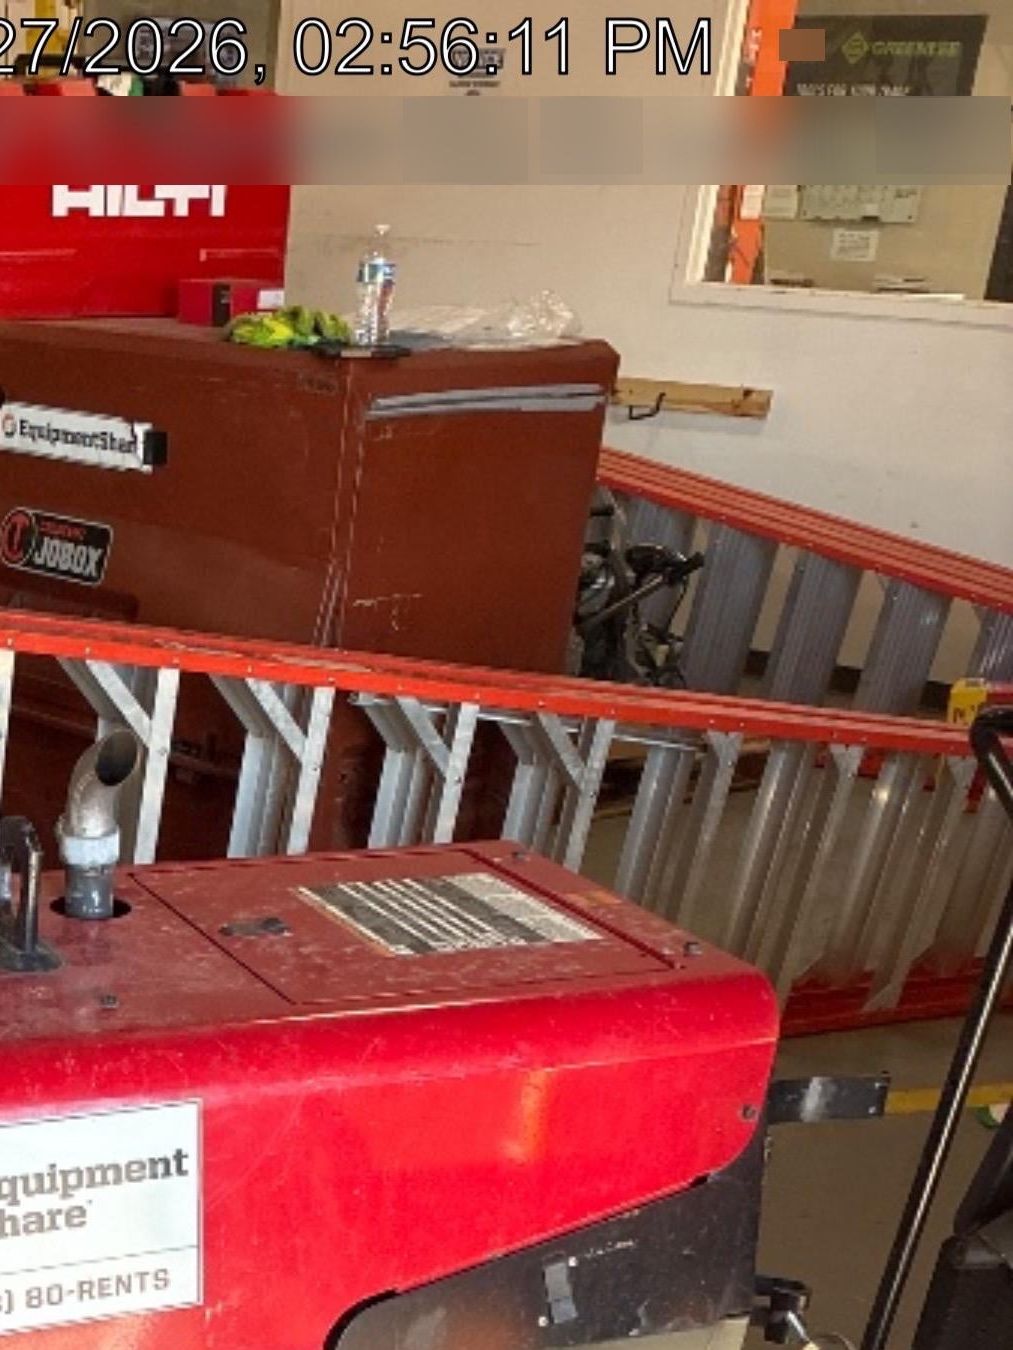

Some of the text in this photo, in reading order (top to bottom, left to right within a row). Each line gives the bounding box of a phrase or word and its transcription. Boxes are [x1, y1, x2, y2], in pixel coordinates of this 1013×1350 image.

[52, 184, 227, 217] HILTI
[34, 535, 104, 578] JOBOX
[25, 1267, 171, 1309] 80-RENTS
